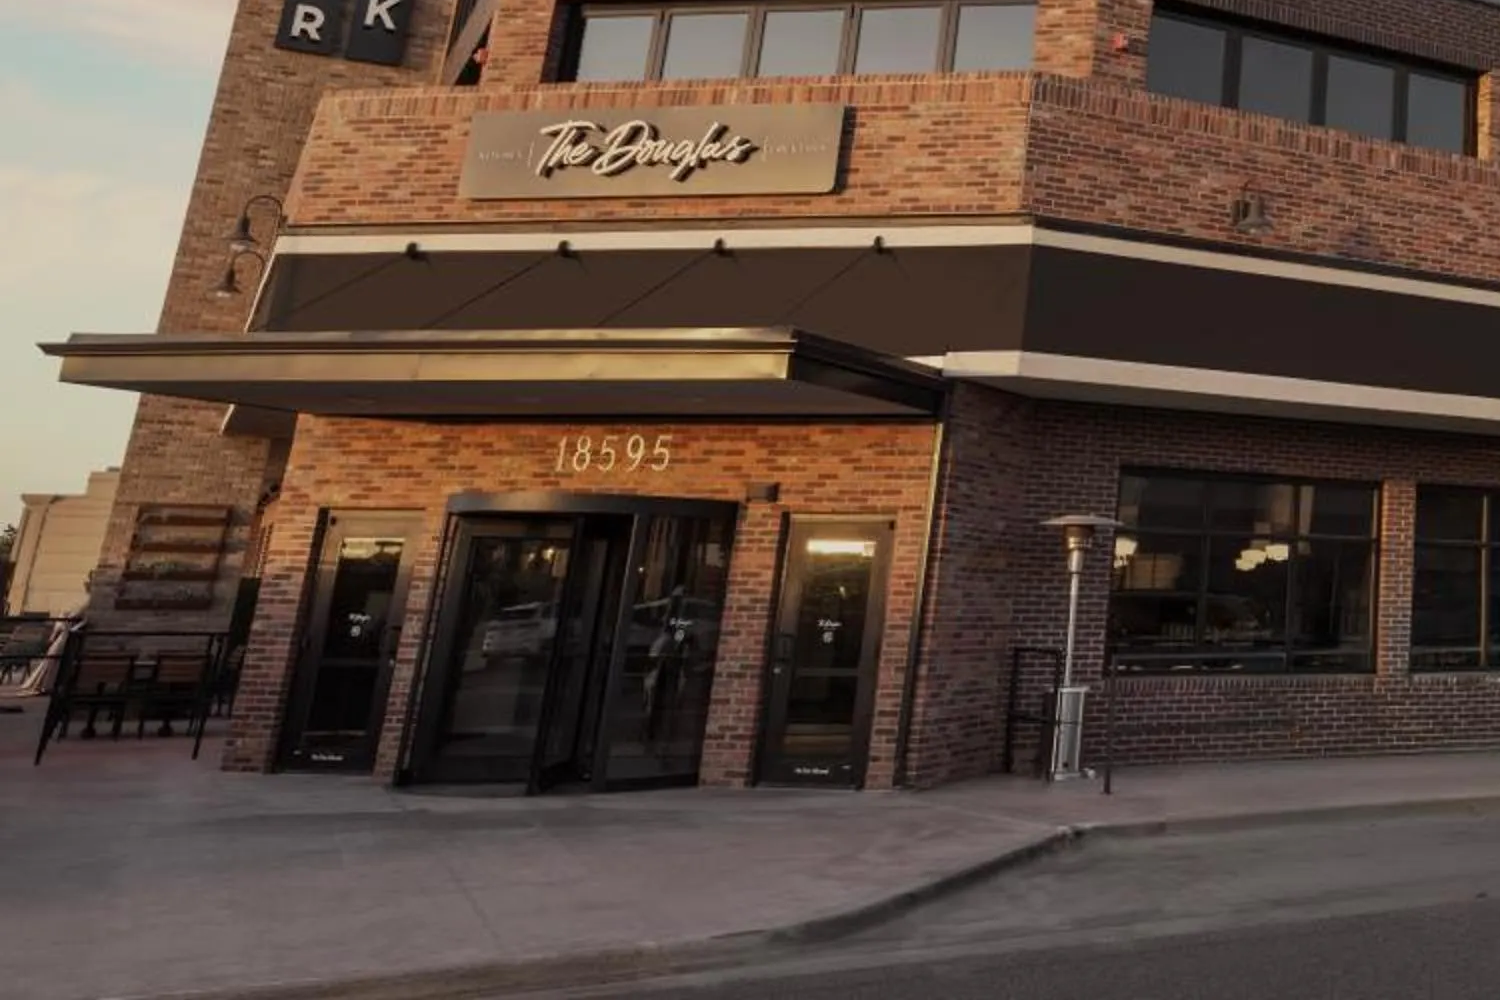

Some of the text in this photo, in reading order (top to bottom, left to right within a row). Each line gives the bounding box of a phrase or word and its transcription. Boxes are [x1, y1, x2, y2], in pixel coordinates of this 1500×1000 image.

[535, 119, 754, 181] The Douglas
[555, 433, 673, 472] 18595
